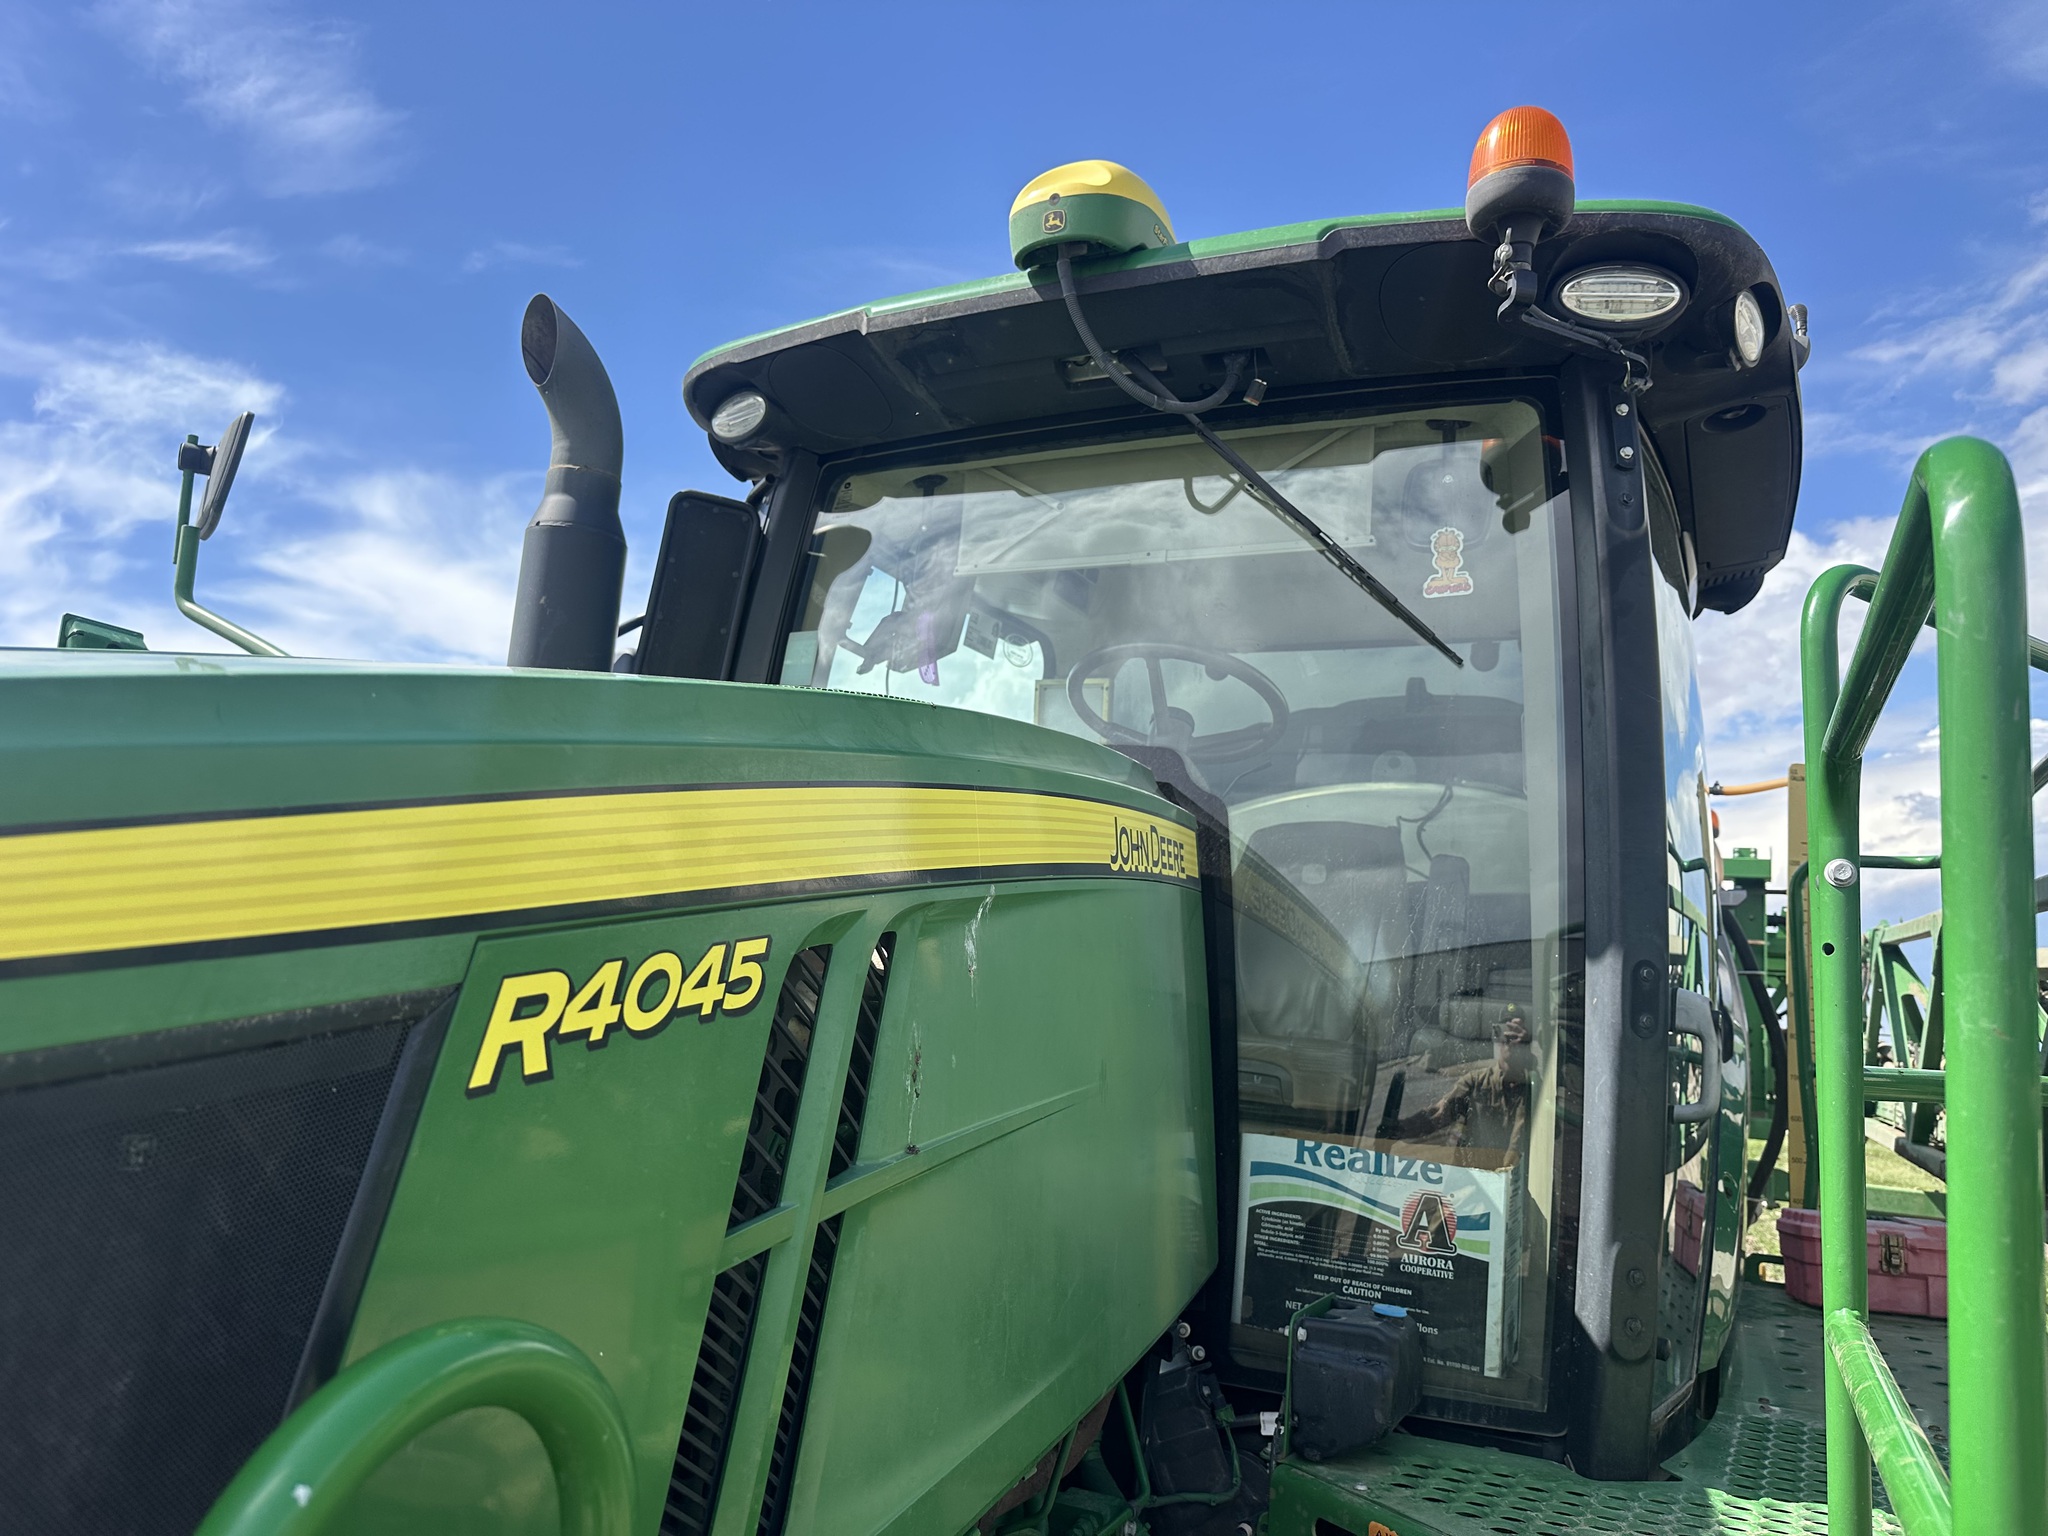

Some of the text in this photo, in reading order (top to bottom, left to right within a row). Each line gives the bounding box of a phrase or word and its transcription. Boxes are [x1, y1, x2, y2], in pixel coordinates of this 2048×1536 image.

[1110, 815, 1187, 879] JOHN DEERE
[465, 934, 772, 1100] R4045
[1294, 1139, 1443, 1185] Realize
[1399, 1263, 1454, 1280] COOPERATIVE
[1400, 1252, 1454, 1271] AURORA
[1313, 1273, 1329, 1281] KEEP
[1351, 1280, 1372, 1289] REACH
[1381, 1285, 1413, 1296] CHILDREN
[1342, 1285, 1382, 1299] CAUTION
[1285, 1299, 1303, 1311] NET
